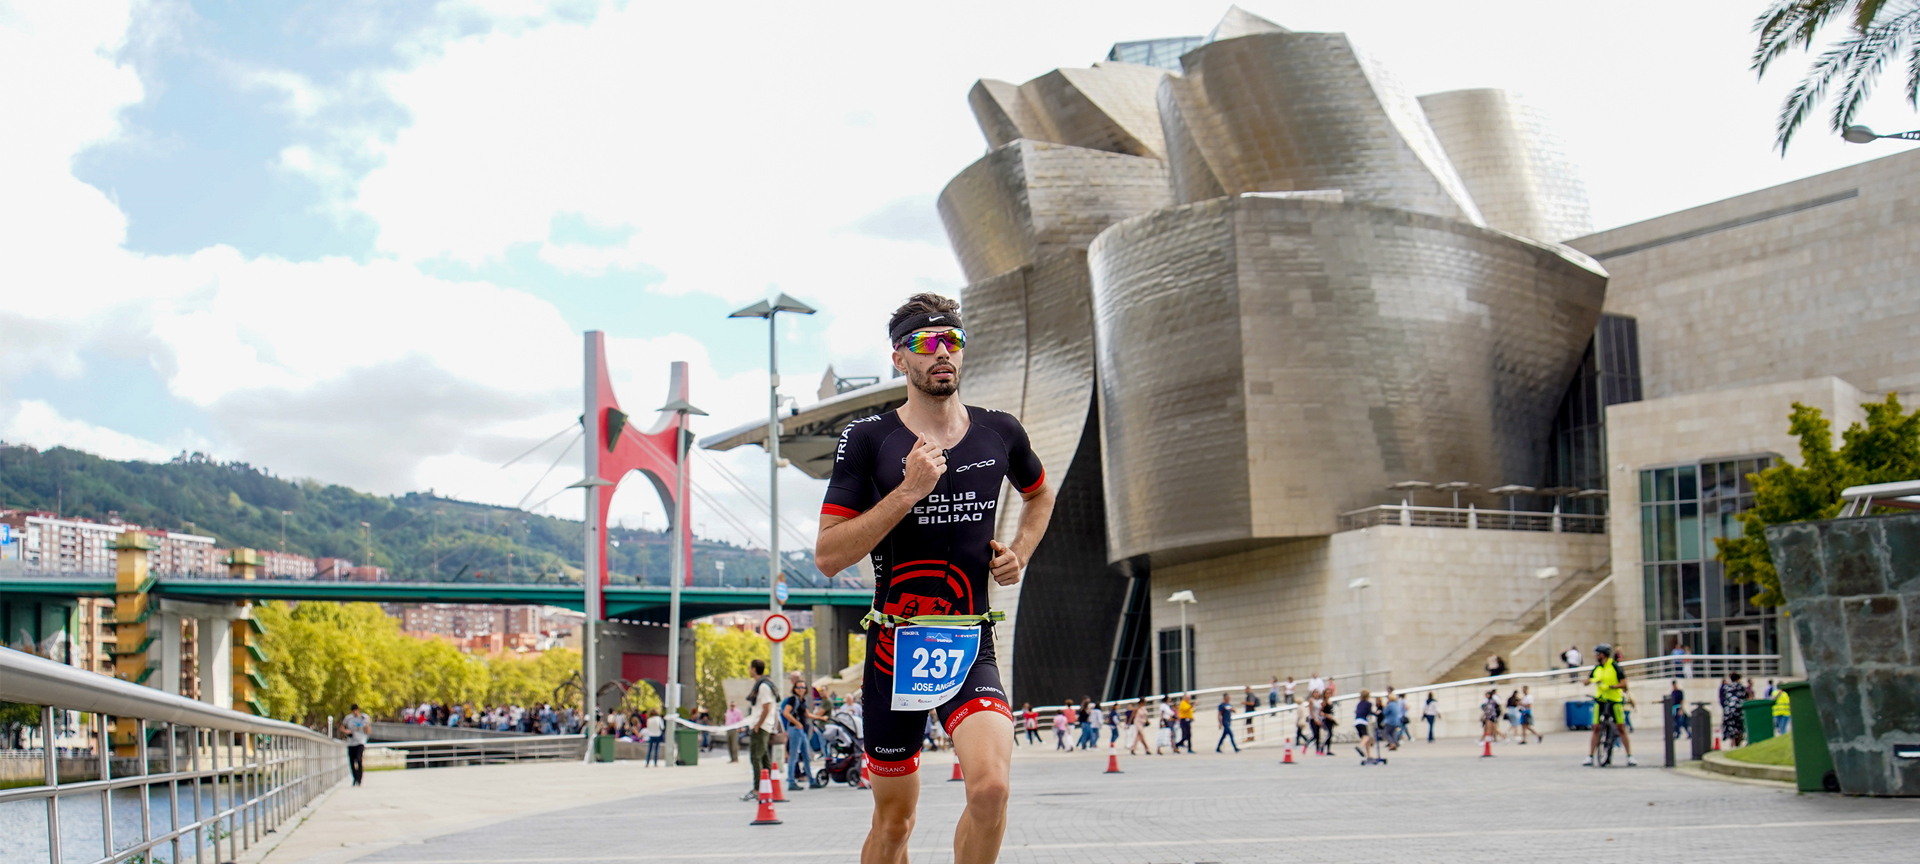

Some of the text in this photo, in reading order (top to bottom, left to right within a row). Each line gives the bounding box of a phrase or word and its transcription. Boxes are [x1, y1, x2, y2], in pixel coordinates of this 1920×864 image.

[956, 459, 996, 473] orca
[928, 491, 976, 503] CLUB
[918, 512, 983, 524] BILBAO
[911, 647, 965, 679] 237
[911, 682, 934, 692] JOSE
[874, 746, 906, 754] CAMPOS
[869, 761, 906, 773] NUTRISANO
